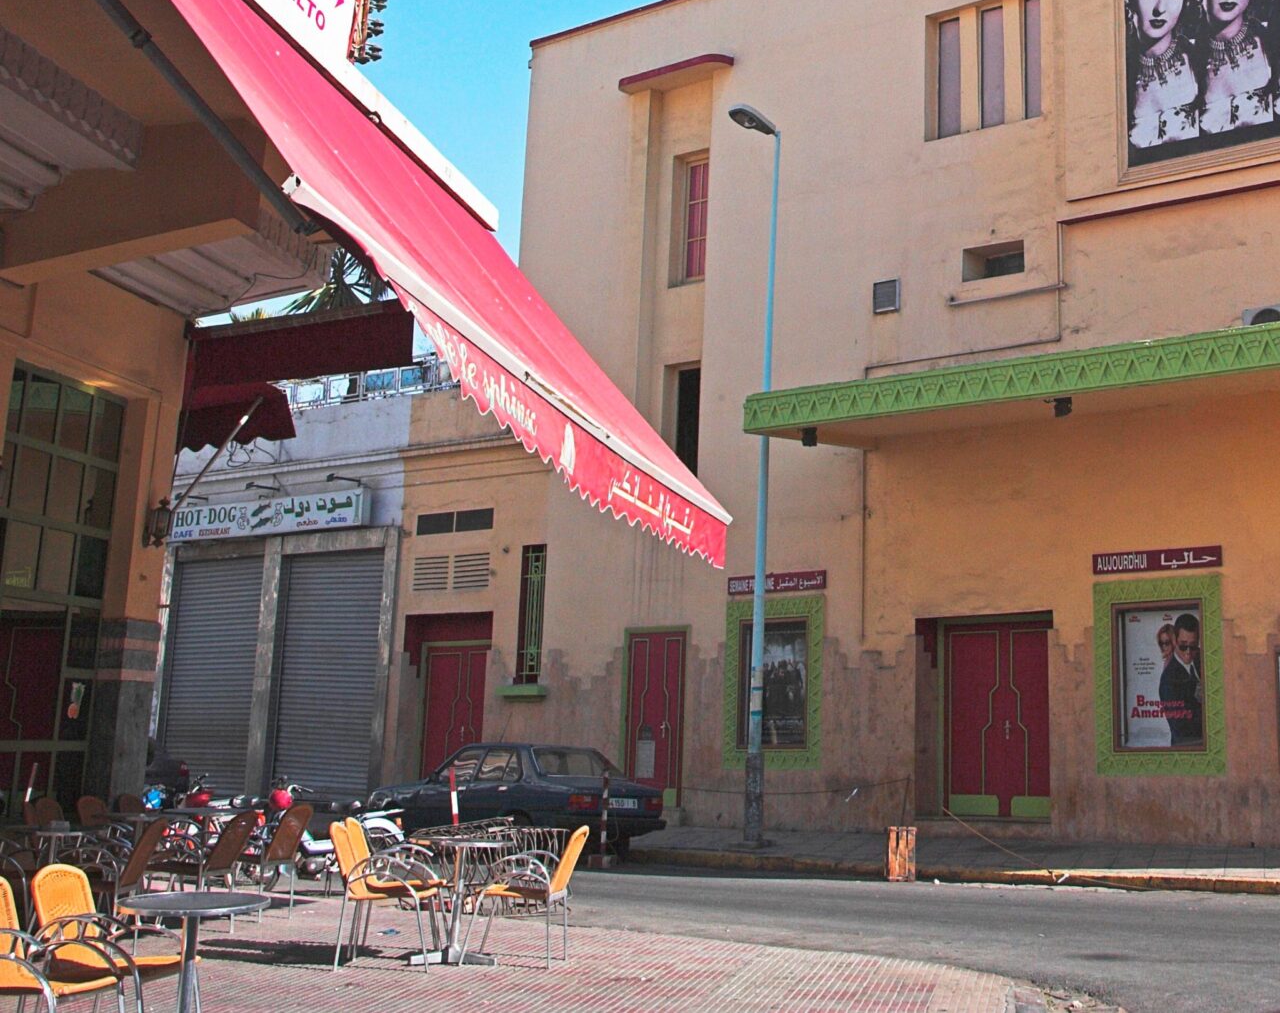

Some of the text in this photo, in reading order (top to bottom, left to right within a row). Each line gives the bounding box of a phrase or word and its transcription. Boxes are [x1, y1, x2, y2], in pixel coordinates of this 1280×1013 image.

[175, 506, 237, 528] HOT-DOG
[173, 529, 193, 539] CAFE
[1097, 551, 1147, 571] AUJOURD'HUI
